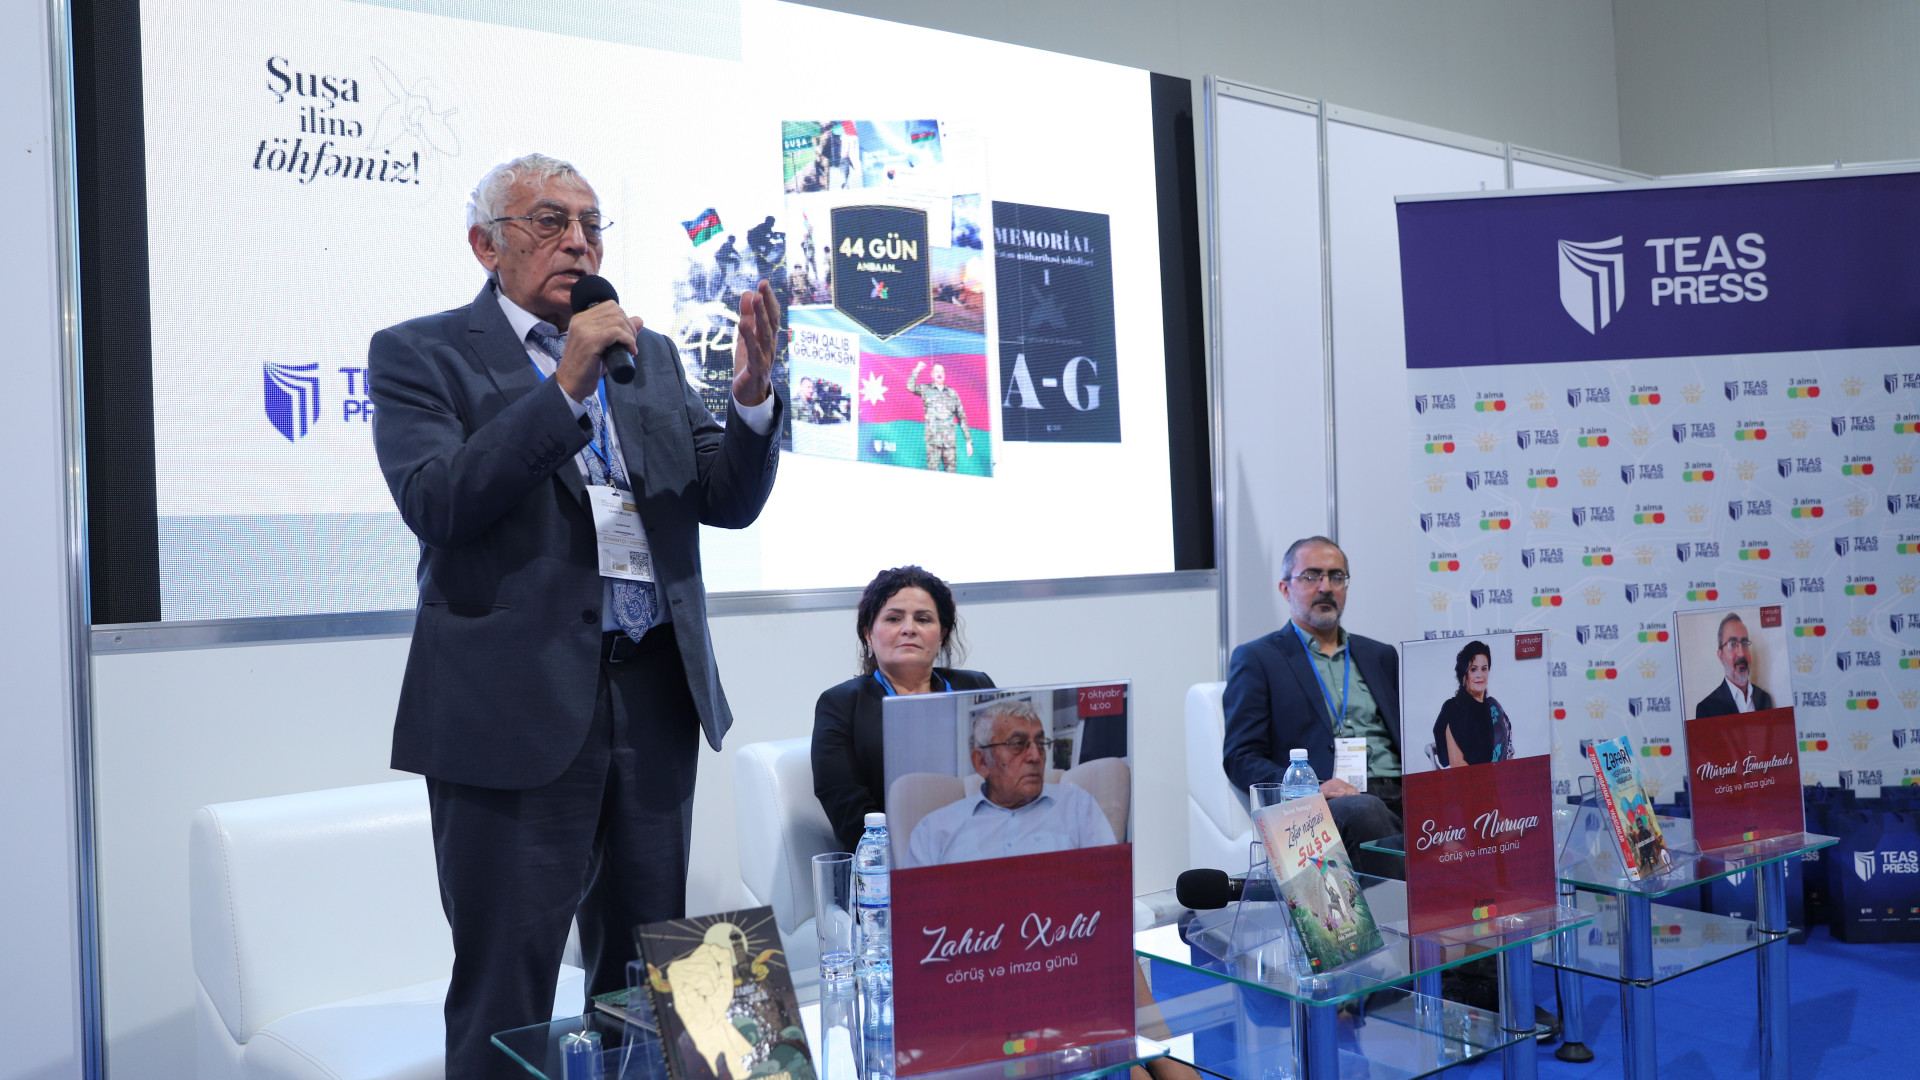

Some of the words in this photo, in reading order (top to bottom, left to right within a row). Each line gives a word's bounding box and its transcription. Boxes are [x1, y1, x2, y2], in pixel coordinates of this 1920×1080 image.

[266, 56, 359, 109] Şuşa
[301, 106, 362, 137] ilinə
[253, 138, 419, 184] töhfəmiz!
[839, 237, 865, 258] 44
[868, 232, 918, 262] GÜN
[1644, 232, 1767, 273] TEAS
[1651, 271, 1769, 306] PRESS
[1586, 387, 1610, 395] TEAS
[1744, 388, 1767, 396] PRESS
[1432, 394, 1455, 402] TEAS
[1586, 395, 1610, 403] PRESS
[1432, 402, 1455, 410] PRESS
[1851, 416, 1874, 424] TEAS
[1904, 413, 1920, 421] alm
[1691, 423, 1715, 431] TEAS
[1851, 423, 1875, 431] PRESS
[1535, 430, 1558, 438] TEAS
[1692, 430, 1715, 438] PRESS
[1797, 458, 1821, 466] TEAS
[1639, 464, 1663, 472] TEAS
[1797, 465, 1821, 473] PRESS
[1640, 472, 1664, 480] PRESS
[1485, 478, 1508, 486] PRESS
[1590, 507, 1614, 515] TEAS
[1747, 508, 1772, 516] PRESS
[1591, 514, 1615, 522] PRESS
[1437, 520, 1461, 528] PRESS
[1854, 536, 1878, 544] TEAS
[1695, 542, 1719, 550] TEAS
[1696, 549, 1719, 558] PRESS
[1540, 556, 1563, 564] PRESS
[1799, 578, 1824, 586] TEAS
[1489, 589, 1512, 597] TEAS
[1800, 585, 1824, 593] PRESS
[1644, 591, 1667, 599] PRESS
[1594, 625, 1618, 633] TEAS
[1594, 632, 1618, 640] PRESS
[1856, 659, 1880, 667] PRESS
[1080, 693, 1086, 702] 7
[1088, 689, 1120, 700] oktyabr
[1802, 692, 1826, 700] TEAS
[1090, 702, 1111, 711] 14:00
[1802, 699, 1826, 707] PRESS
[1858, 770, 1882, 778] TEAS
[1416, 819, 1467, 851] Sevinc
[1465, 850, 1475, 858] və
[1478, 845, 1497, 856] imza
[1500, 840, 1520, 854] günü
[1880, 851, 1918, 863] TEAS
[1882, 863, 1919, 874] PRESS
[920, 923, 1005, 965] Zahid
[1020, 910, 1101, 951] Xəlil
[989, 966, 1006, 977] və
[1010, 960, 1041, 975] imza
[1045, 953, 1078, 972] günü
